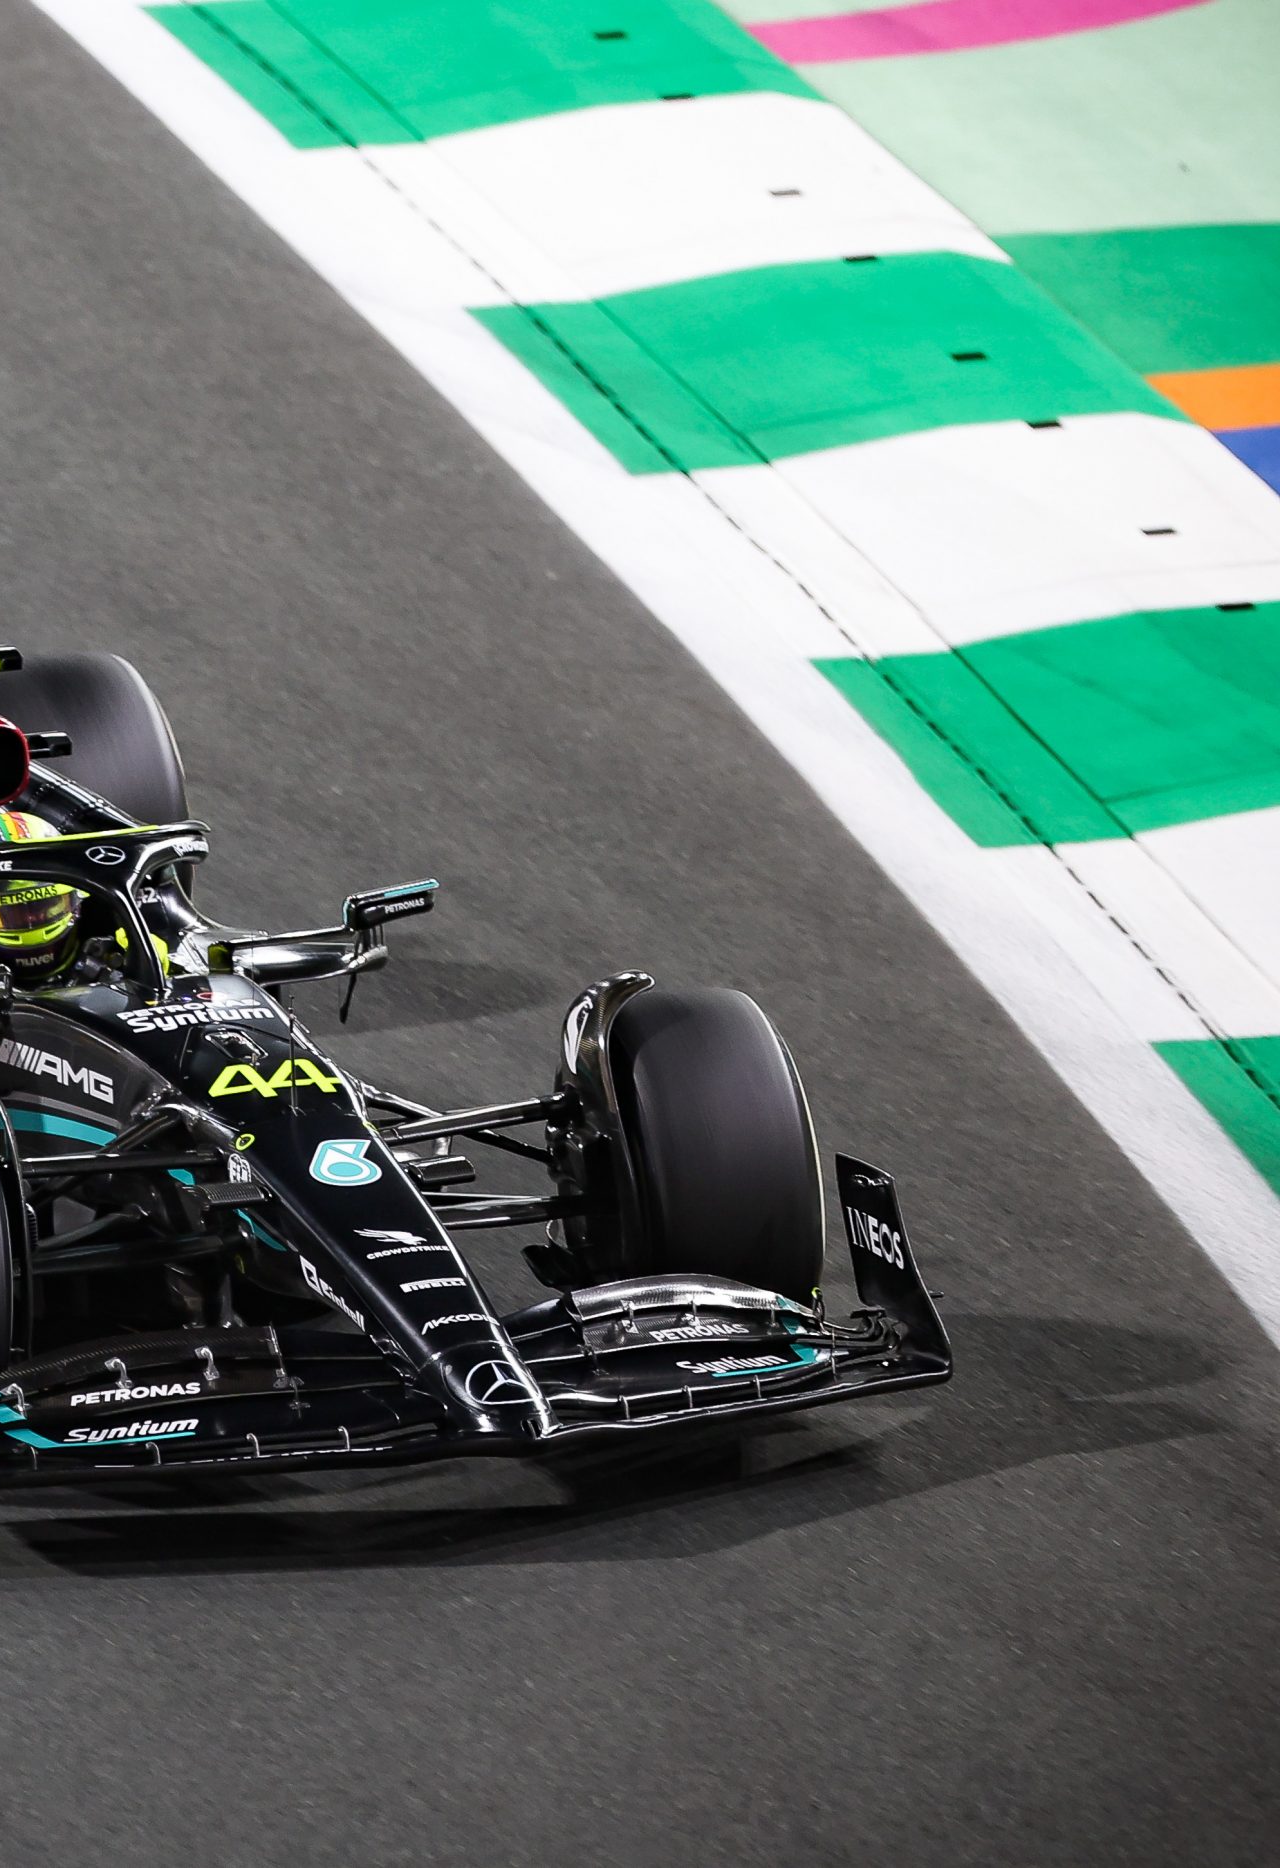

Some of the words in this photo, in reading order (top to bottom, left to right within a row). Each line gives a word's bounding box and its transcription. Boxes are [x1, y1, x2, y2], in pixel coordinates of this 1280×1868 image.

[385, 898, 425, 914] PETRONAS
[126, 1007, 274, 1033] Syntium
[34, 1051, 114, 1104] AMG
[208, 1059, 344, 1097] 44
[846, 1206, 904, 1270] INEOS
[366, 1245, 451, 1260] CROWDSTRIKE
[649, 1323, 750, 1342] PETRONAS
[676, 1355, 789, 1374] Syntium
[70, 1382, 201, 1406] PETRONAS
[63, 1418, 199, 1443] Syntium
